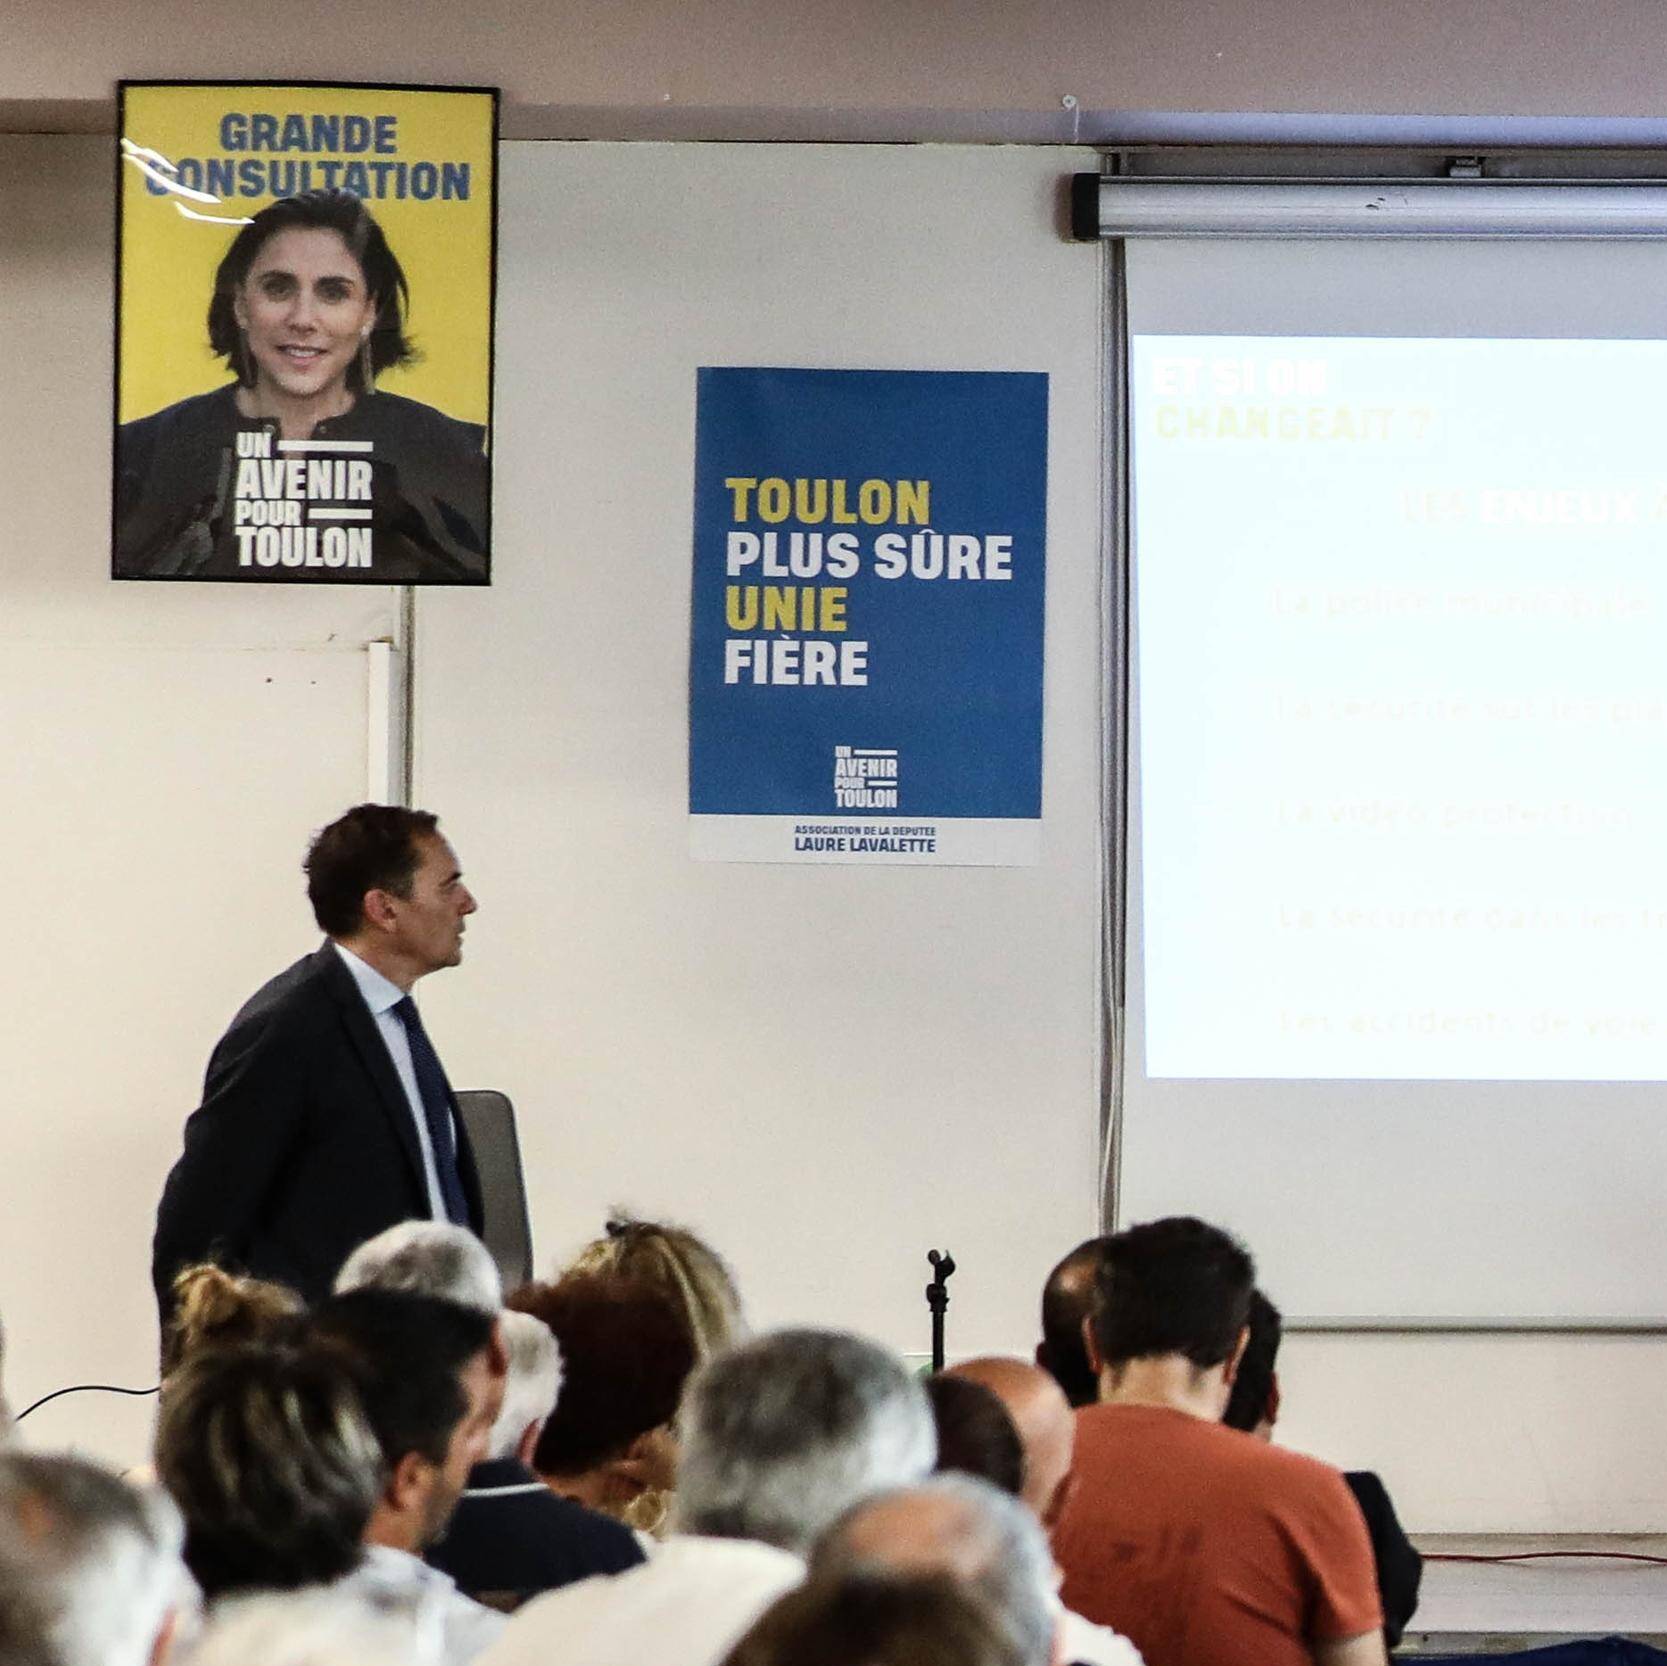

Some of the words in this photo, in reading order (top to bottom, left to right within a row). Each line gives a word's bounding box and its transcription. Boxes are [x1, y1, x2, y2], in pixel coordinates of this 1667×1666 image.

[220, 112, 397, 154] GRANDE
[1155, 404, 1394, 441] CHANGEAIT
[236, 432, 271, 458] UN
[235, 459, 373, 499] AVENIR
[235, 500, 302, 526] POUR
[725, 477, 930, 525] TOULON
[235, 527, 373, 568] TOULON
[726, 531, 860, 578] PLUS
[874, 528, 1013, 580] SÛRE
[725, 585, 847, 632] UNIE
[724, 634, 868, 686] FIÈRE
[835, 759, 898, 777] AVENIR
[834, 789, 898, 808] TOULON
[795, 825, 861, 836] ASSOCIATION
[864, 826, 876, 836] DE
[879, 826, 890, 836] LA
[795, 836, 846, 852] LAURE
[849, 837, 936, 853] LAVALETTE
